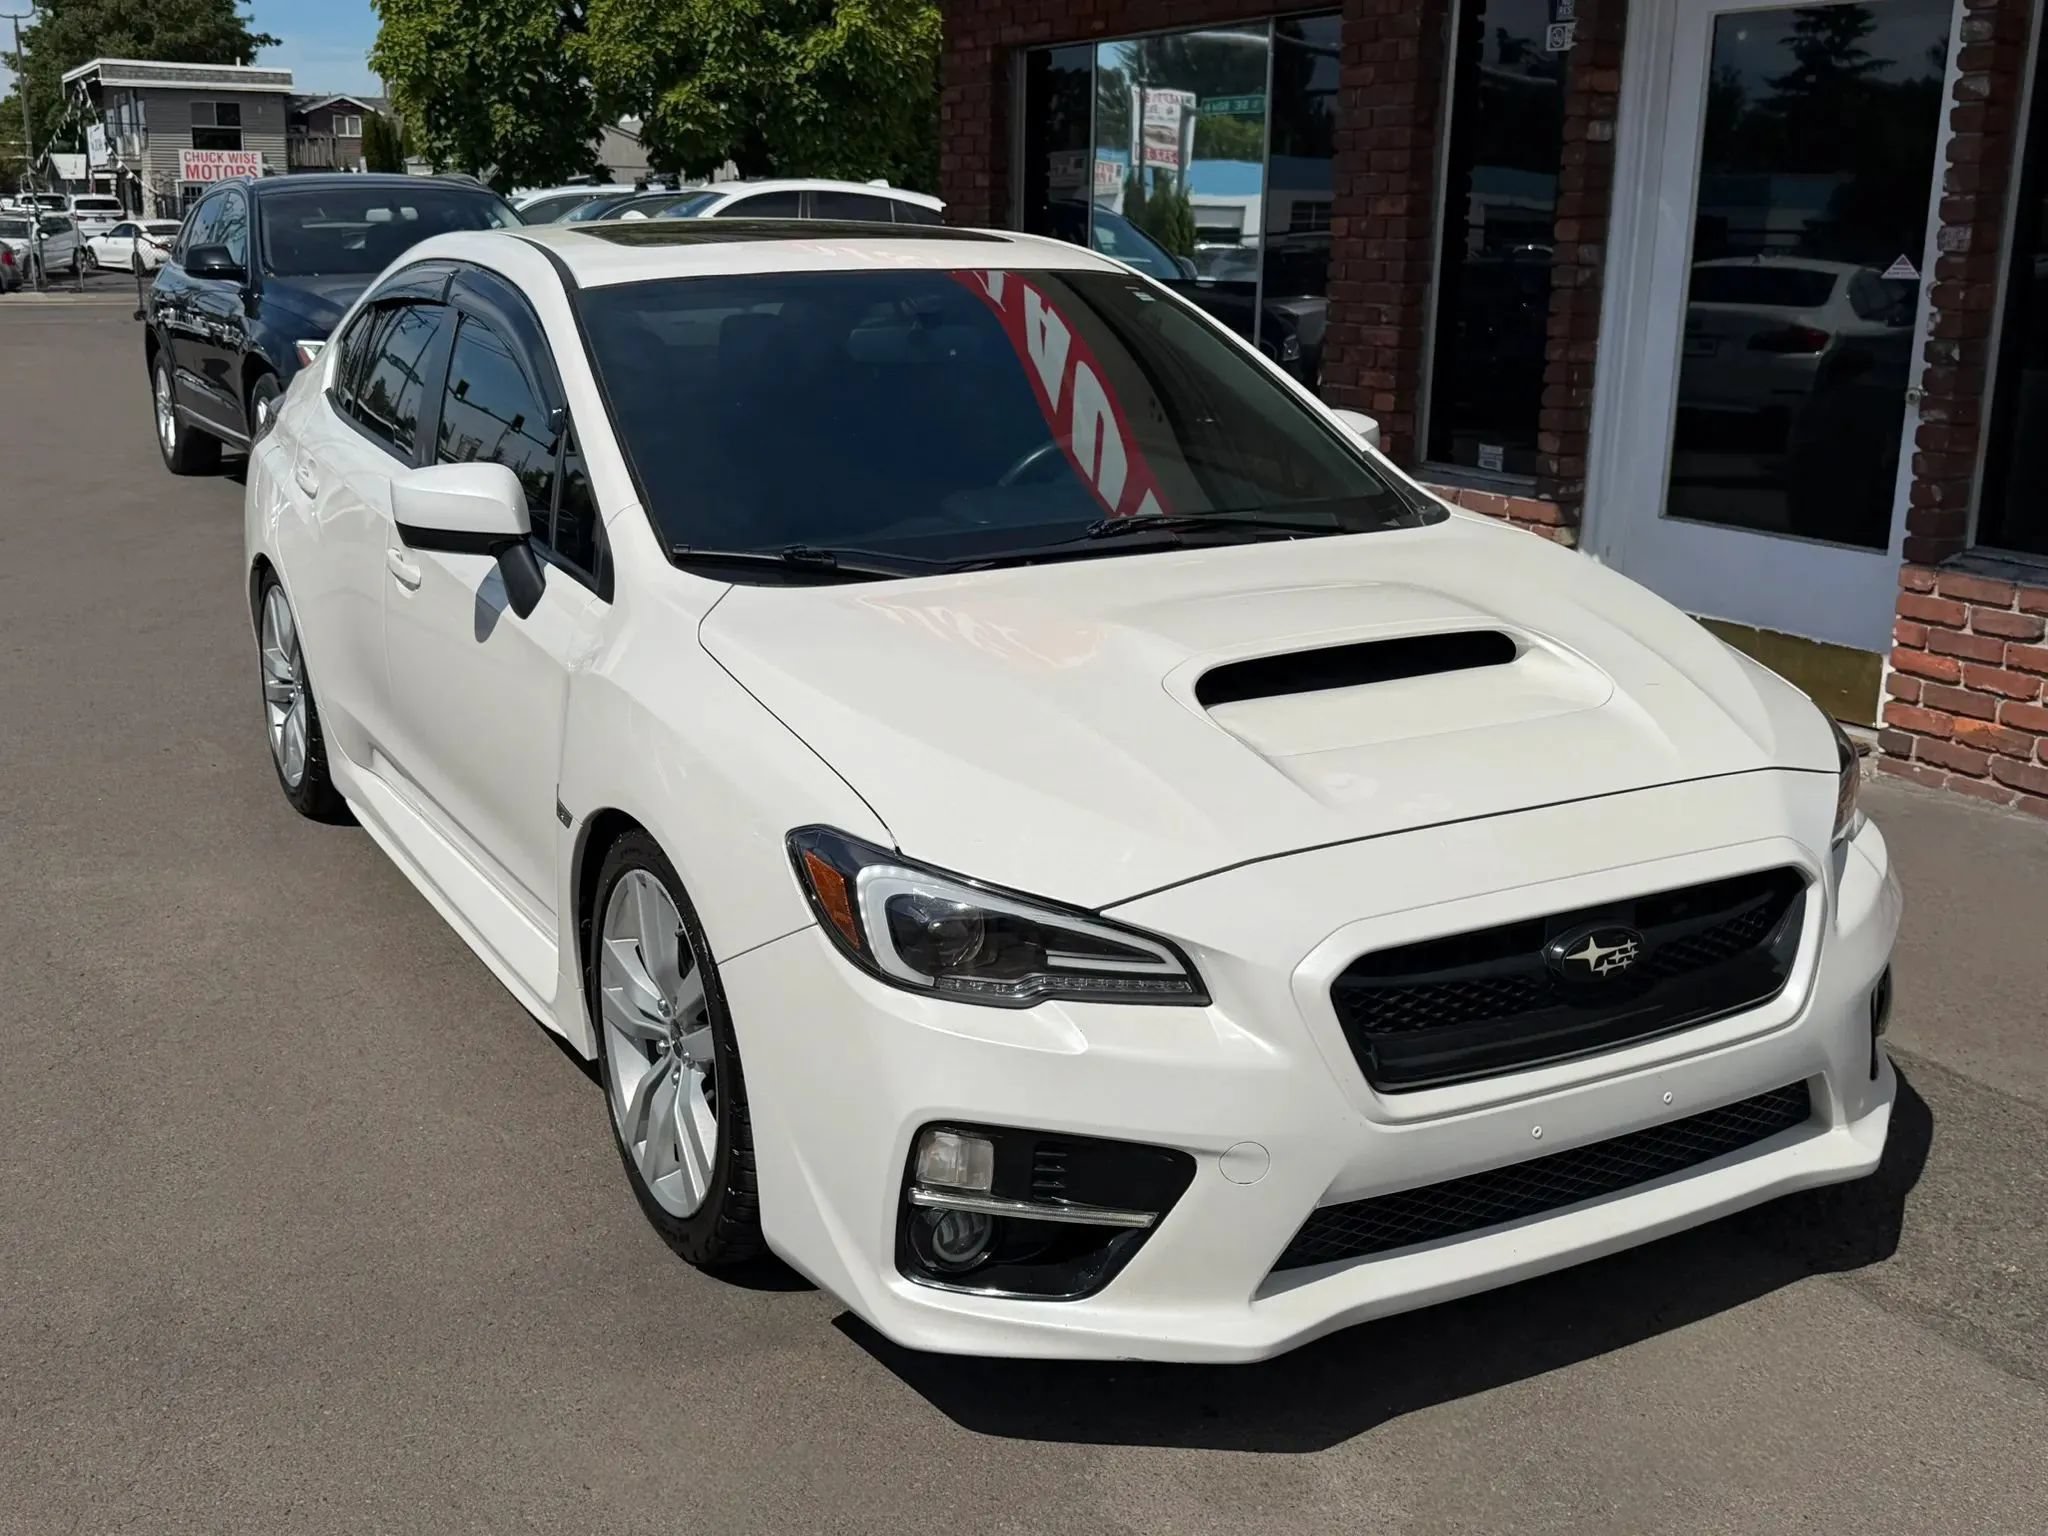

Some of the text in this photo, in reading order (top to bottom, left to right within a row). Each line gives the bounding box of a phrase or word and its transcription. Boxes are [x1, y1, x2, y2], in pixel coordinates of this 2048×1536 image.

[184, 151, 257, 164] CHUCK WISE
[185, 164, 258, 180] MOTORS
